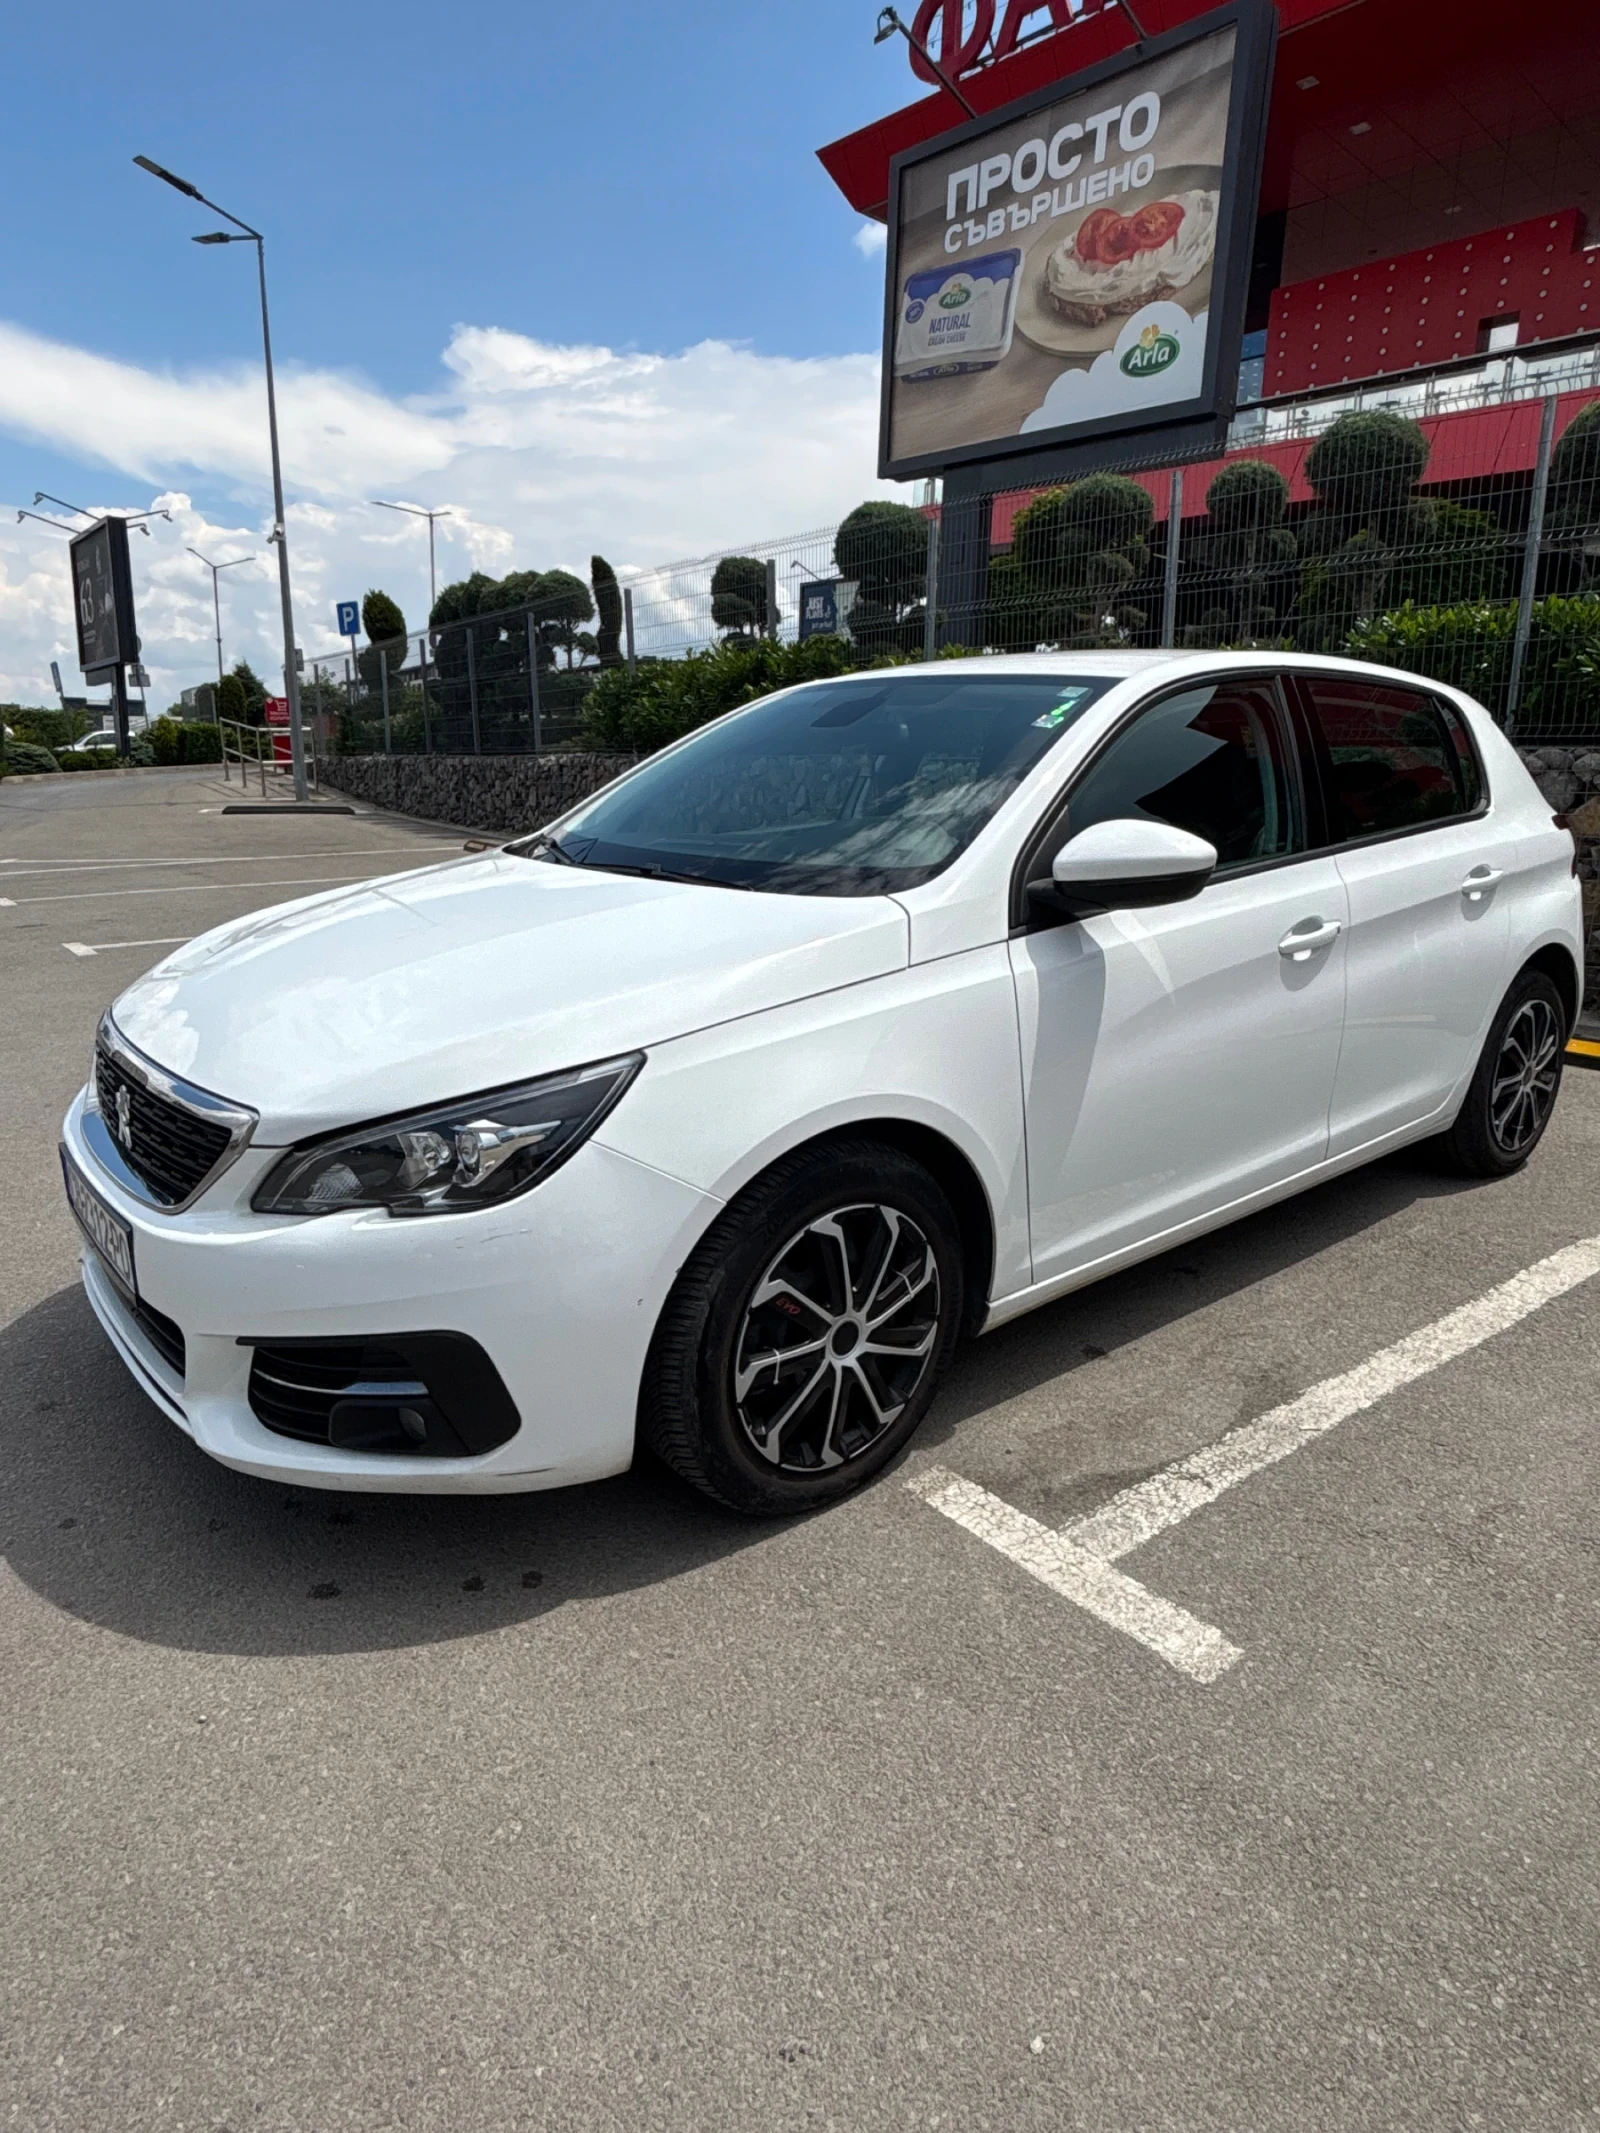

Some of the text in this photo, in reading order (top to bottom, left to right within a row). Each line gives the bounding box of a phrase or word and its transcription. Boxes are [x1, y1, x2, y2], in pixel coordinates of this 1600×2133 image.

[946, 91, 1161, 221] ПРОСТО
[944, 152, 1155, 254] СЪВЪРШЕНО
[942, 291, 967, 306] Arla
[928, 312, 971, 334] NATURAL
[1127, 342, 1170, 370] Arla
[342, 606, 355, 632] P
